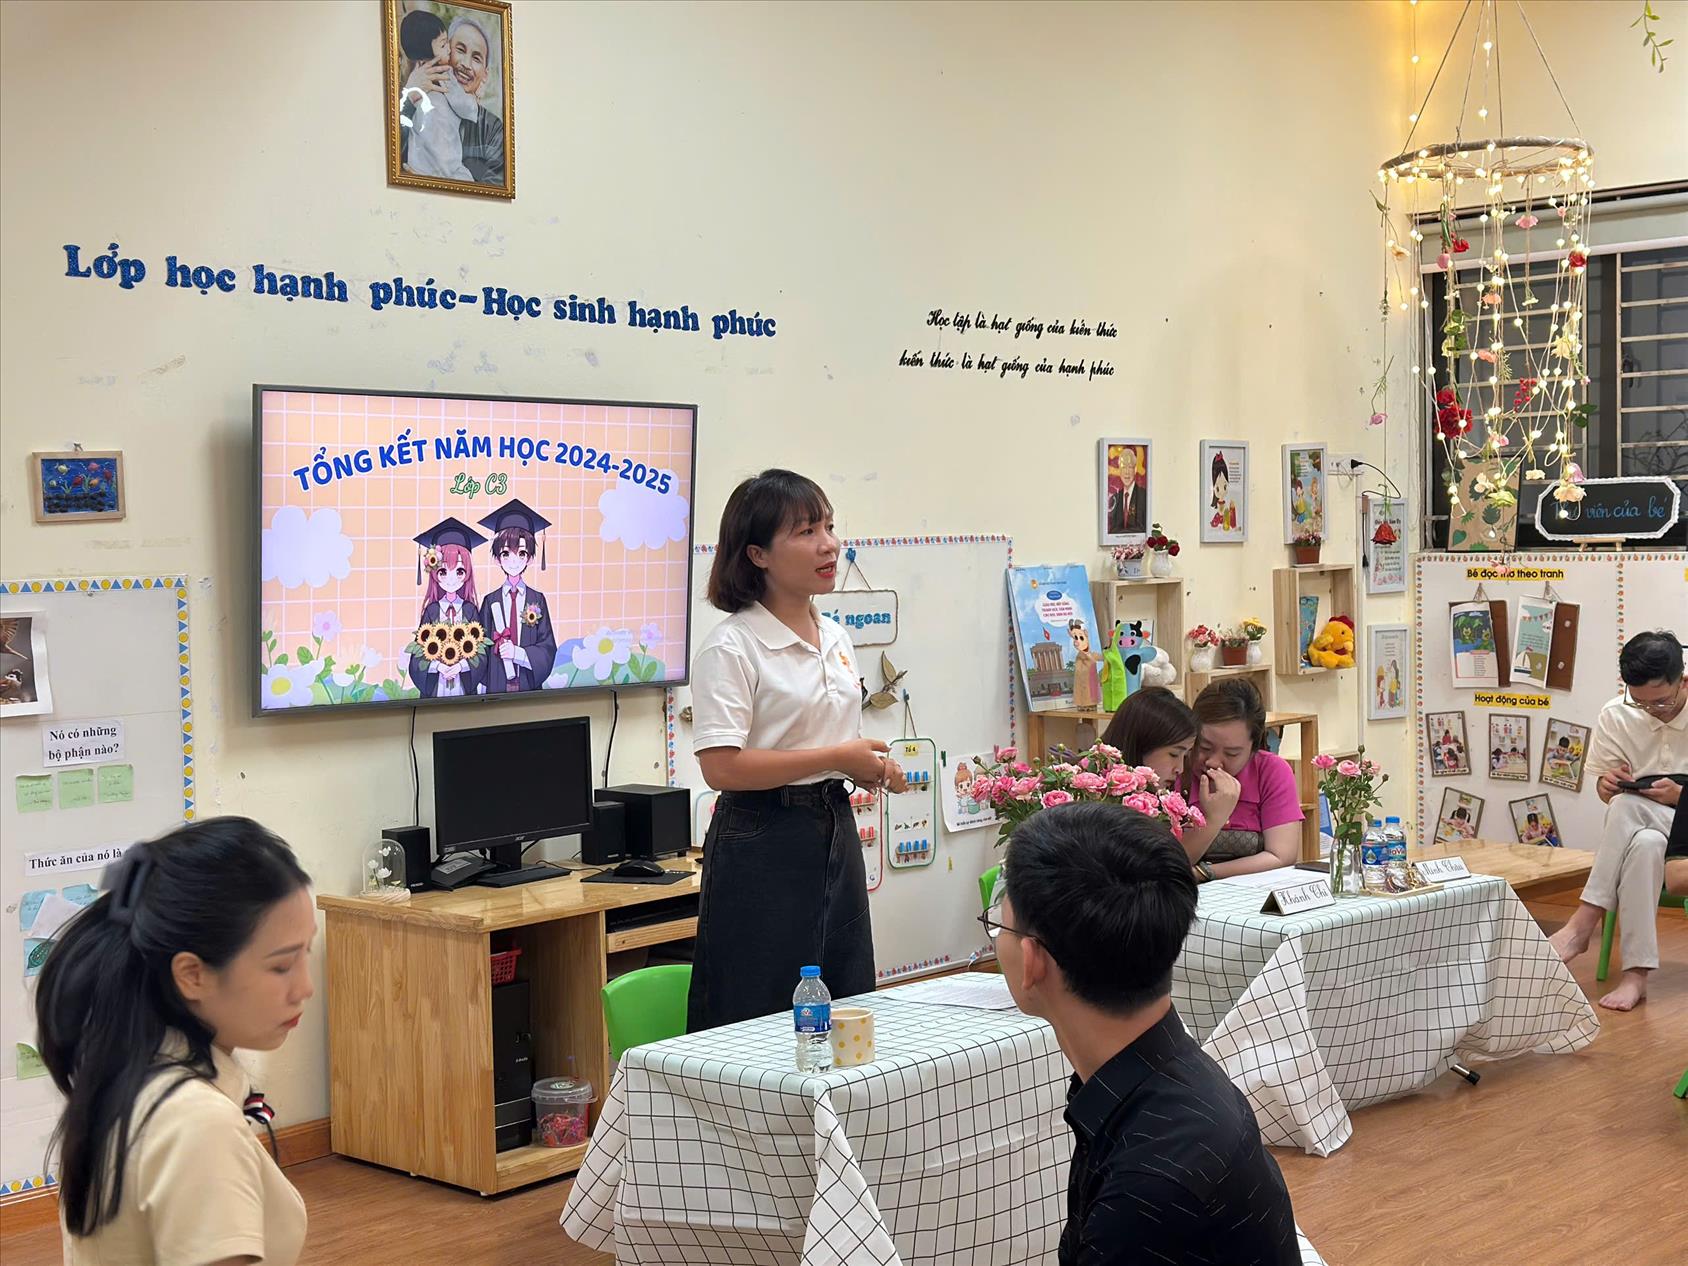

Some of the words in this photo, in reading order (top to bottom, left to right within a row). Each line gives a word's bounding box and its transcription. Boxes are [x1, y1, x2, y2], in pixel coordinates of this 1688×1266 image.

[63, 242, 146, 289] Lớp
[165, 255, 236, 295] học
[252, 264, 348, 302] hạnh
[553, 294, 617, 325] sinh
[628, 300, 700, 334] hạnh
[712, 309, 776, 340] phúc
[926, 308, 951, 331] Học
[953, 311, 971, 334] tập
[975, 310, 986, 329] là
[991, 313, 1012, 334] hạt
[1014, 316, 1044, 339] giống
[1046, 319, 1065, 334] của
[1069, 318, 1091, 336] kiến
[1096, 321, 1117, 337] thức
[899, 349, 924, 367] kiến
[929, 351, 955, 368] thức
[961, 352, 973, 369] là
[977, 353, 998, 373] hạt
[1000, 355, 1029, 379] giống
[1034, 357, 1053, 373] của
[1058, 358, 1085, 377] hạnh
[1088, 359, 1114, 381] phúc
[293, 446, 371, 491] TỔNG
[380, 427, 427, 469] KẾT
[434, 428, 492, 460] NĂM
[499, 436, 550, 467] HỌC
[555, 443, 672, 495] 2024-2025
[450, 472, 481, 499] Lớp
[485, 472, 507, 495] C3
[1613, 499, 1641, 518] của
[1648, 495, 1668, 518] bé
[1467, 569, 1478, 578] Bé
[1481, 569, 1498, 579] đọc
[1517, 569, 1538, 578] theo
[1540, 569, 1564, 578] tranh
[845, 612, 892, 629] ngoan
[1475, 694, 1493, 704] Hoạt
[1495, 695, 1518, 706] động
[1519, 696, 1536, 705] của
[1537, 697, 1550, 706] bé
[50, 729, 65, 741] Nó
[68, 729, 80, 740] có
[83, 726, 117, 739] những
[49, 749, 62, 762] bộ
[65, 748, 91, 762] phận
[94, 743, 119, 756] nào?
[29, 856, 57, 870] Thức
[60, 855, 73, 866] ăn
[75, 853, 94, 863] của
[97, 851, 110, 862] nó
[112, 848, 122, 858] là
